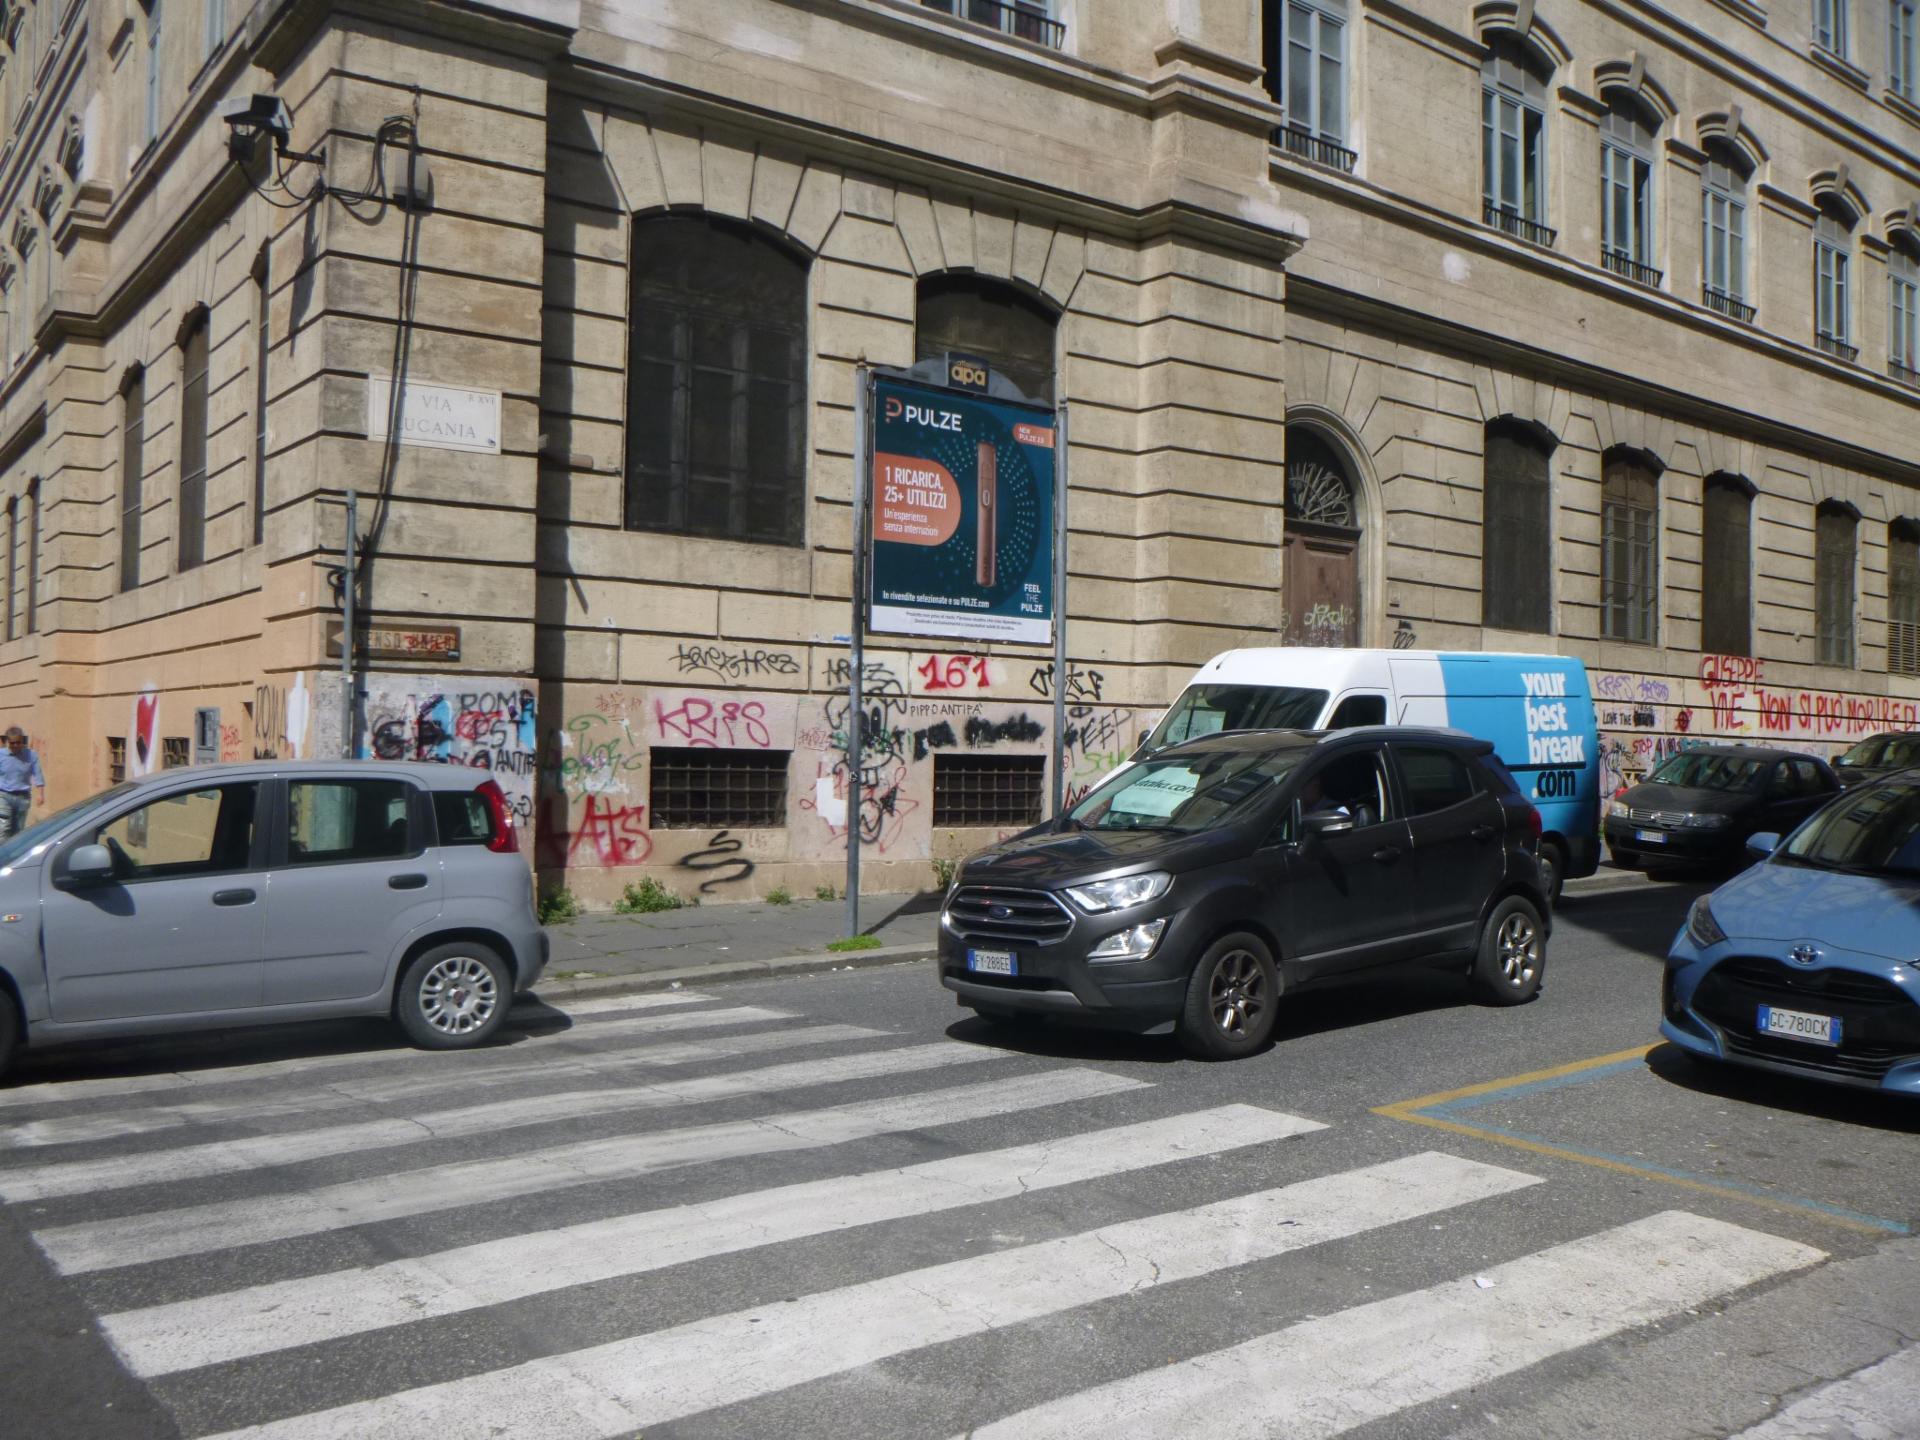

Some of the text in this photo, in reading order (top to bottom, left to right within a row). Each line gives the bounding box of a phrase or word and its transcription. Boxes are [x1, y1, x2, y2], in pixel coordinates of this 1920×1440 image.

[421, 394, 452, 412] VIA
[905, 404, 963, 432] PULZE
[885, 466, 944, 492] 1 RICARICA,
[884, 485, 947, 509] 25+ UTILIZZI
[883, 590, 889, 600] In
[1024, 584, 1041, 593] FEEL
[1026, 593, 1039, 602] THE
[1020, 602, 1043, 613] PULZE
[918, 654, 991, 691] 161
[1520, 672, 1566, 699] your
[910, 703, 938, 717] PIPPO
[1524, 698, 1568, 732] best
[1527, 733, 1585, 765] break
[1531, 769, 1576, 798] .com
